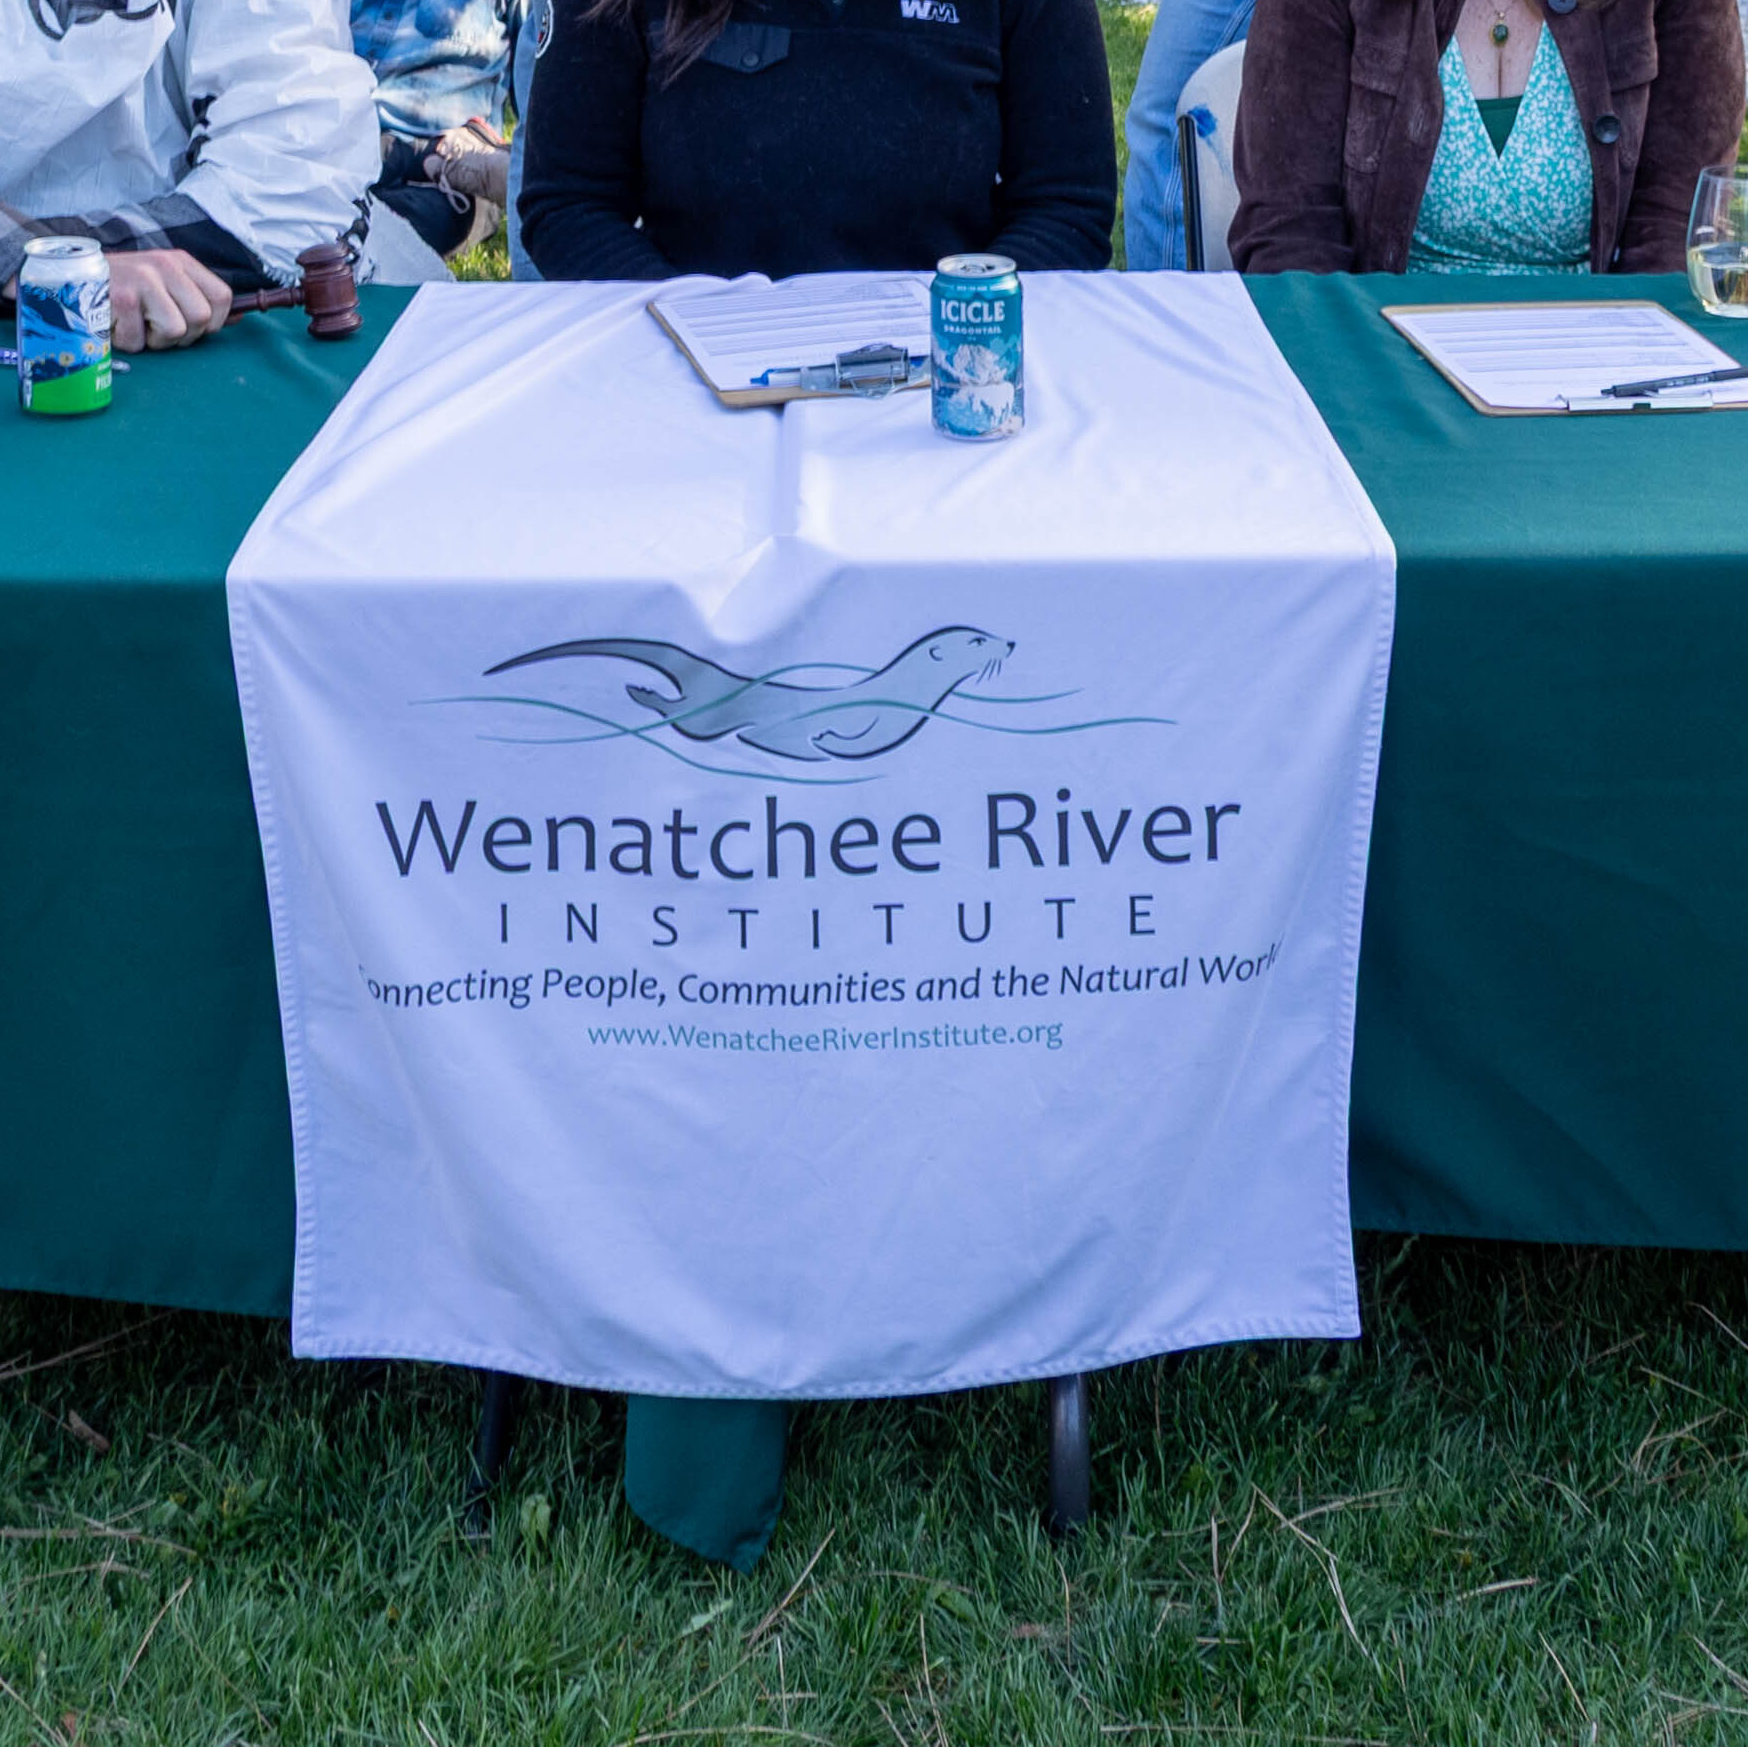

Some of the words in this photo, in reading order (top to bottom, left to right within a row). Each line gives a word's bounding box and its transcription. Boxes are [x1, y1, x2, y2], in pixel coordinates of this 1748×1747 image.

[940, 299, 1005, 323] ICICLE
[375, 796, 942, 881] Wenatchee
[986, 787, 1243, 869] River
[499, 893, 1157, 951] INSTITUTE
[358, 963, 534, 1010] onnecting
[541, 967, 667, 1008] People,
[677, 971, 906, 1007] Communities
[915, 966, 982, 1002] and
[992, 964, 1050, 998] the
[1059, 956, 1190, 996] Natural
[587, 1022, 1065, 1053] www.WenatcheeRiverInstitute.org
